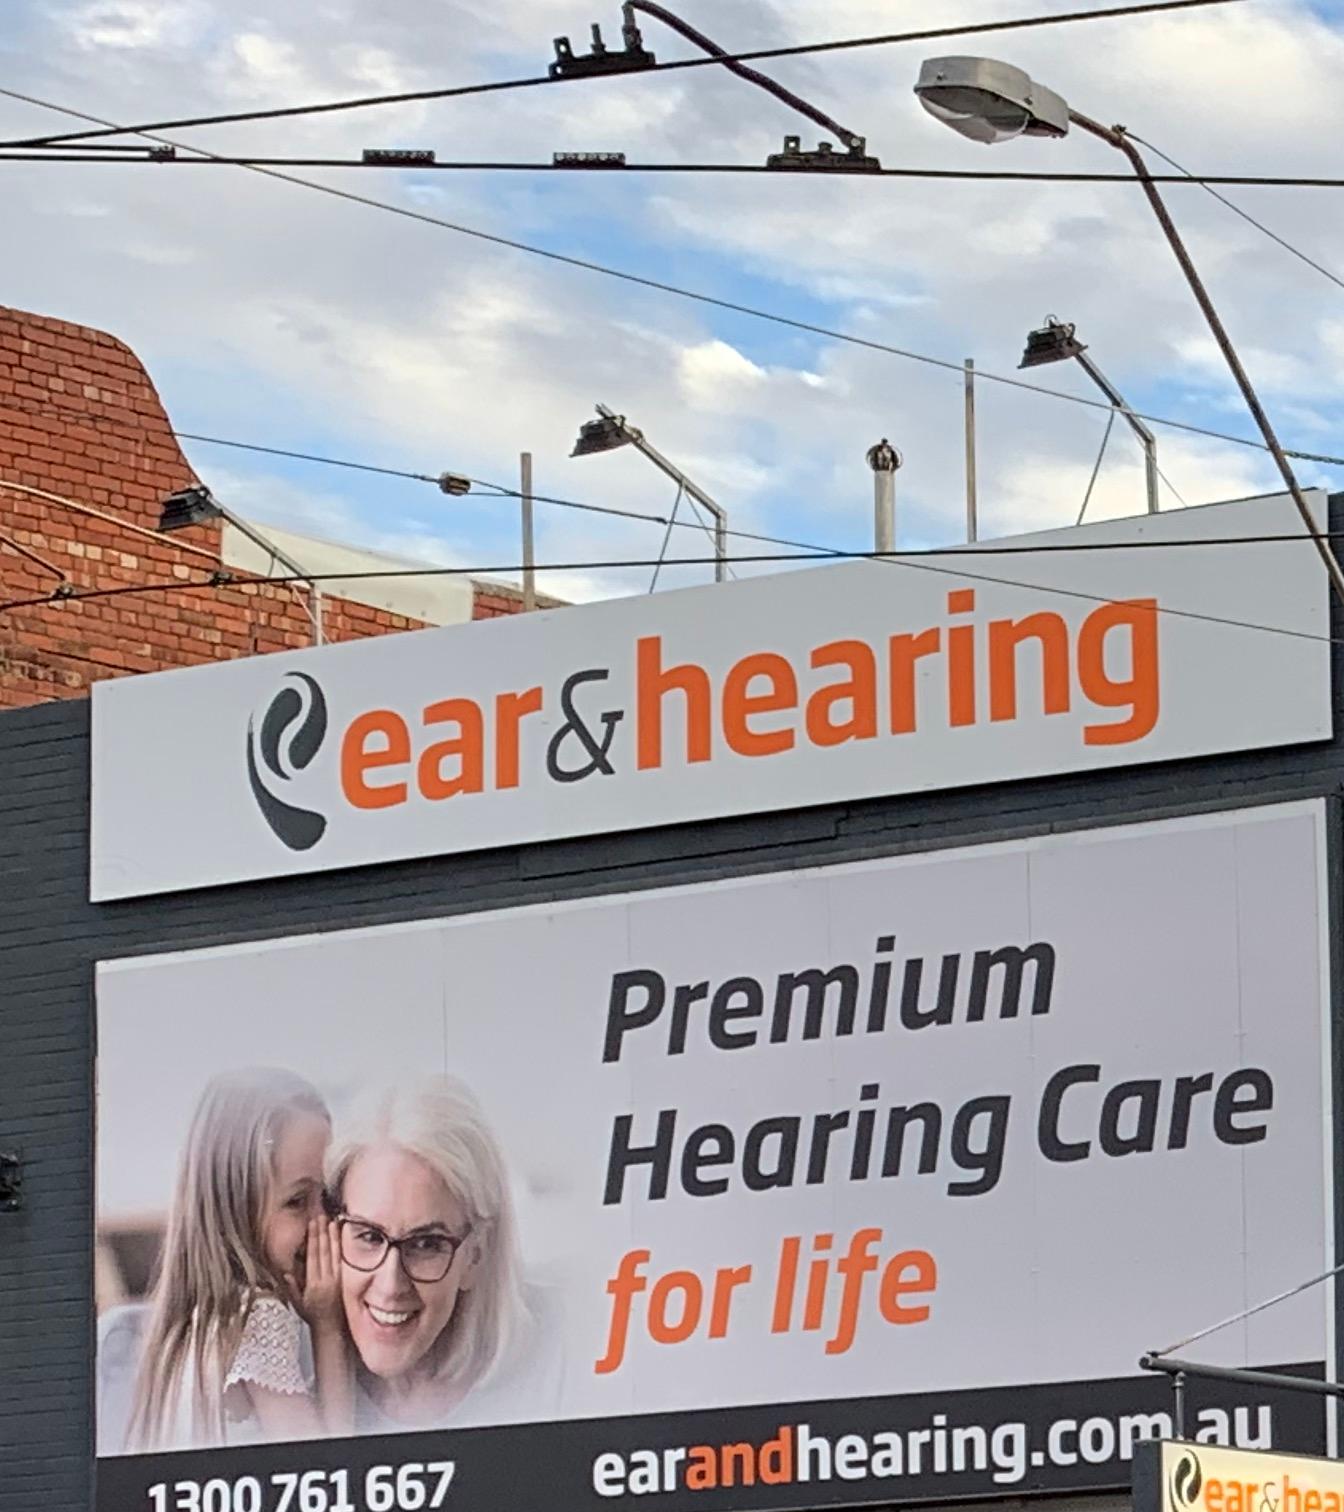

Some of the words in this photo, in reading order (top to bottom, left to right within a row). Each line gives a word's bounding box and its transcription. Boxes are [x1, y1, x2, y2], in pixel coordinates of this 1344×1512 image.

[339, 588, 1161, 810] ear&hearing
[602, 935, 1056, 1063] Premium
[603, 1082, 1012, 1206] Hearing
[1037, 1063, 1274, 1163] Care
[594, 1249, 753, 1375] for
[771, 1227, 938, 1355] life
[365, 1461, 455, 1512] 667
[593, 1405, 1271, 1497] earandhearing.comau
